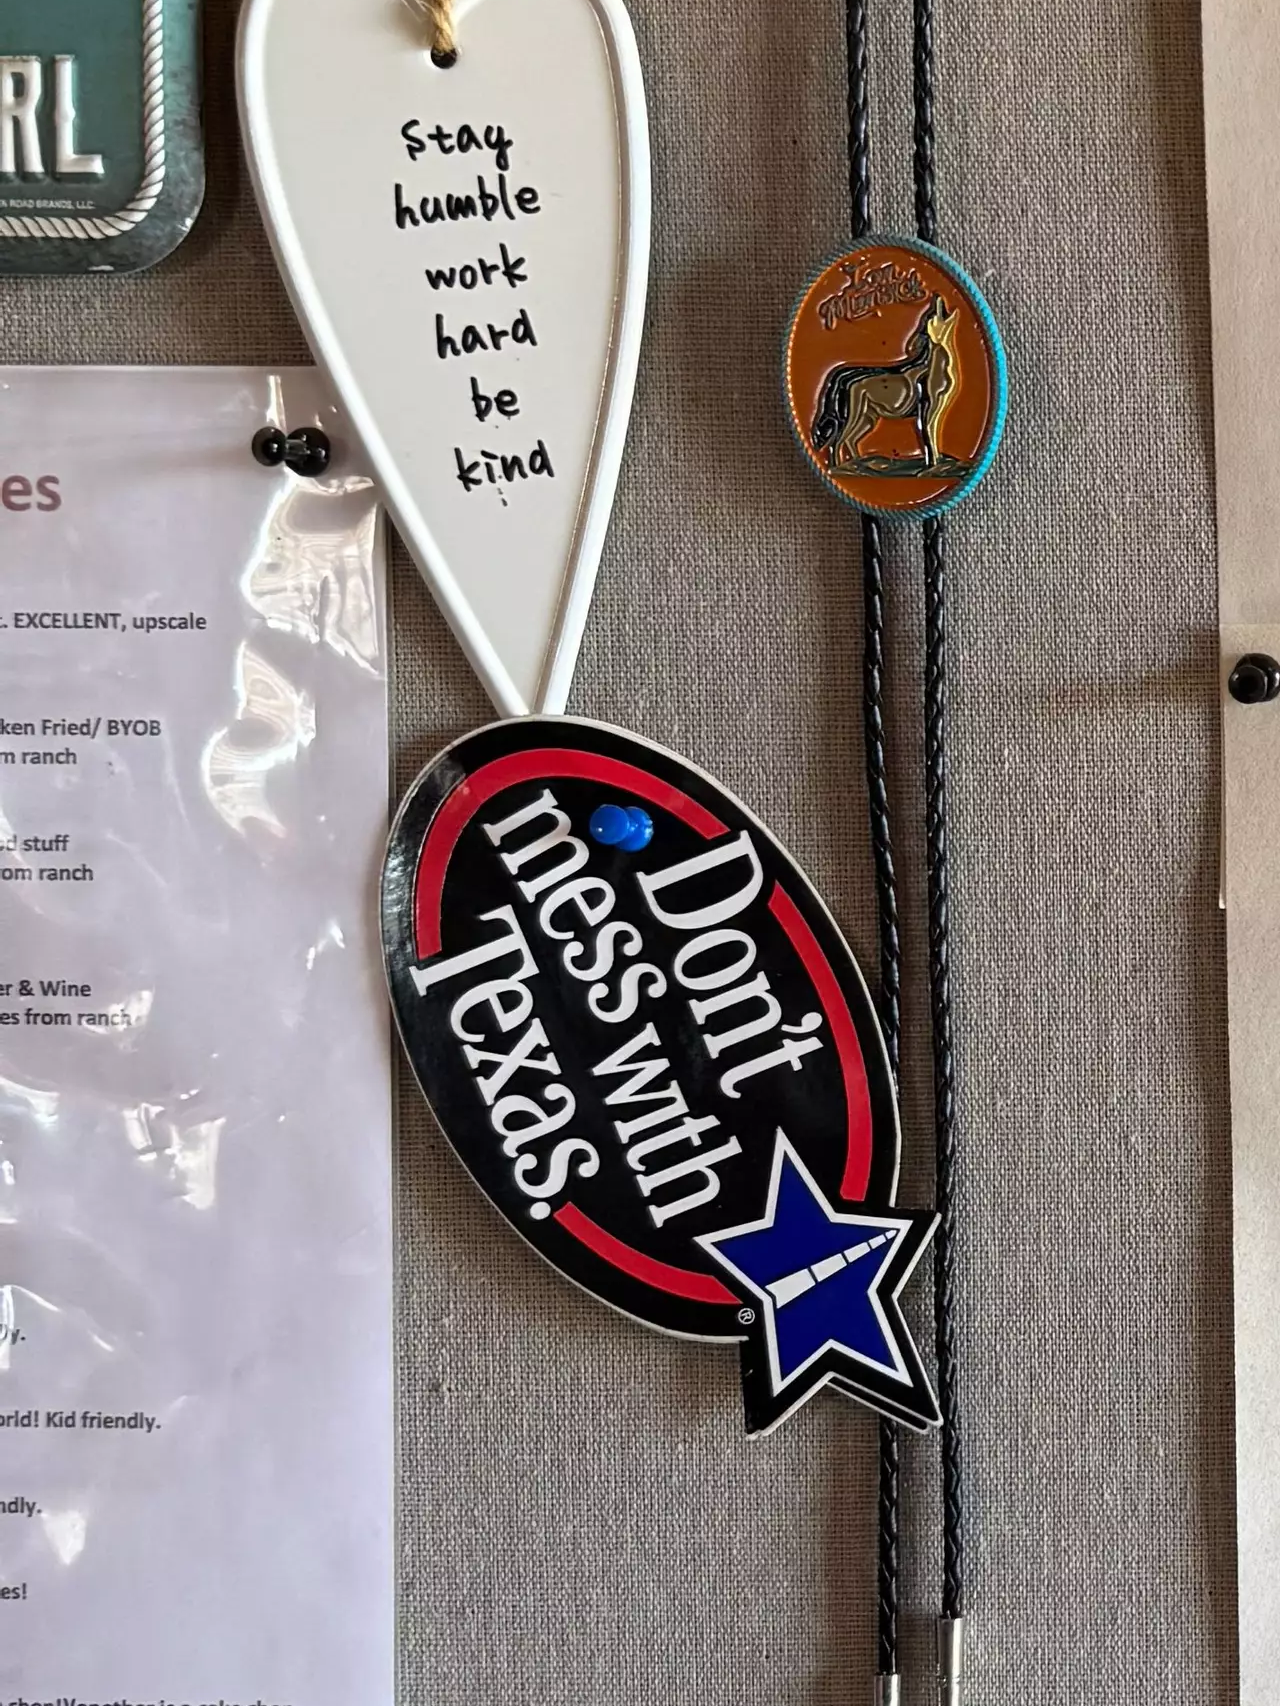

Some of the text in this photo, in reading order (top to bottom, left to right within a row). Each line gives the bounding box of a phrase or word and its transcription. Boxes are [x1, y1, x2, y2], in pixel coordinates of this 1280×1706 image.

[9, 199, 35, 209] ROAD
[393, 174, 541, 229] humble
[425, 242, 529, 291] work
[435, 308, 538, 360] hard
[470, 376, 521, 422] be
[453, 438, 556, 492] kind
[13, 611, 207, 634] EXCELLENT, upscale
[41, 716, 102, 740] Fried/
[107, 719, 162, 737] BYOB
[21, 747, 77, 765] ranch
[22, 834, 70, 852] stuff
[38, 863, 94, 882] ranch
[638, 831, 823, 1100] Don't
[18, 979, 92, 998] & Wine
[25, 1007, 72, 1026] from
[480, 788, 743, 1230] mess with
[409, 904, 601, 1222] Texas.
[45, 1410, 77, 1429] Kid
[80, 1410, 162, 1434] friendly.
